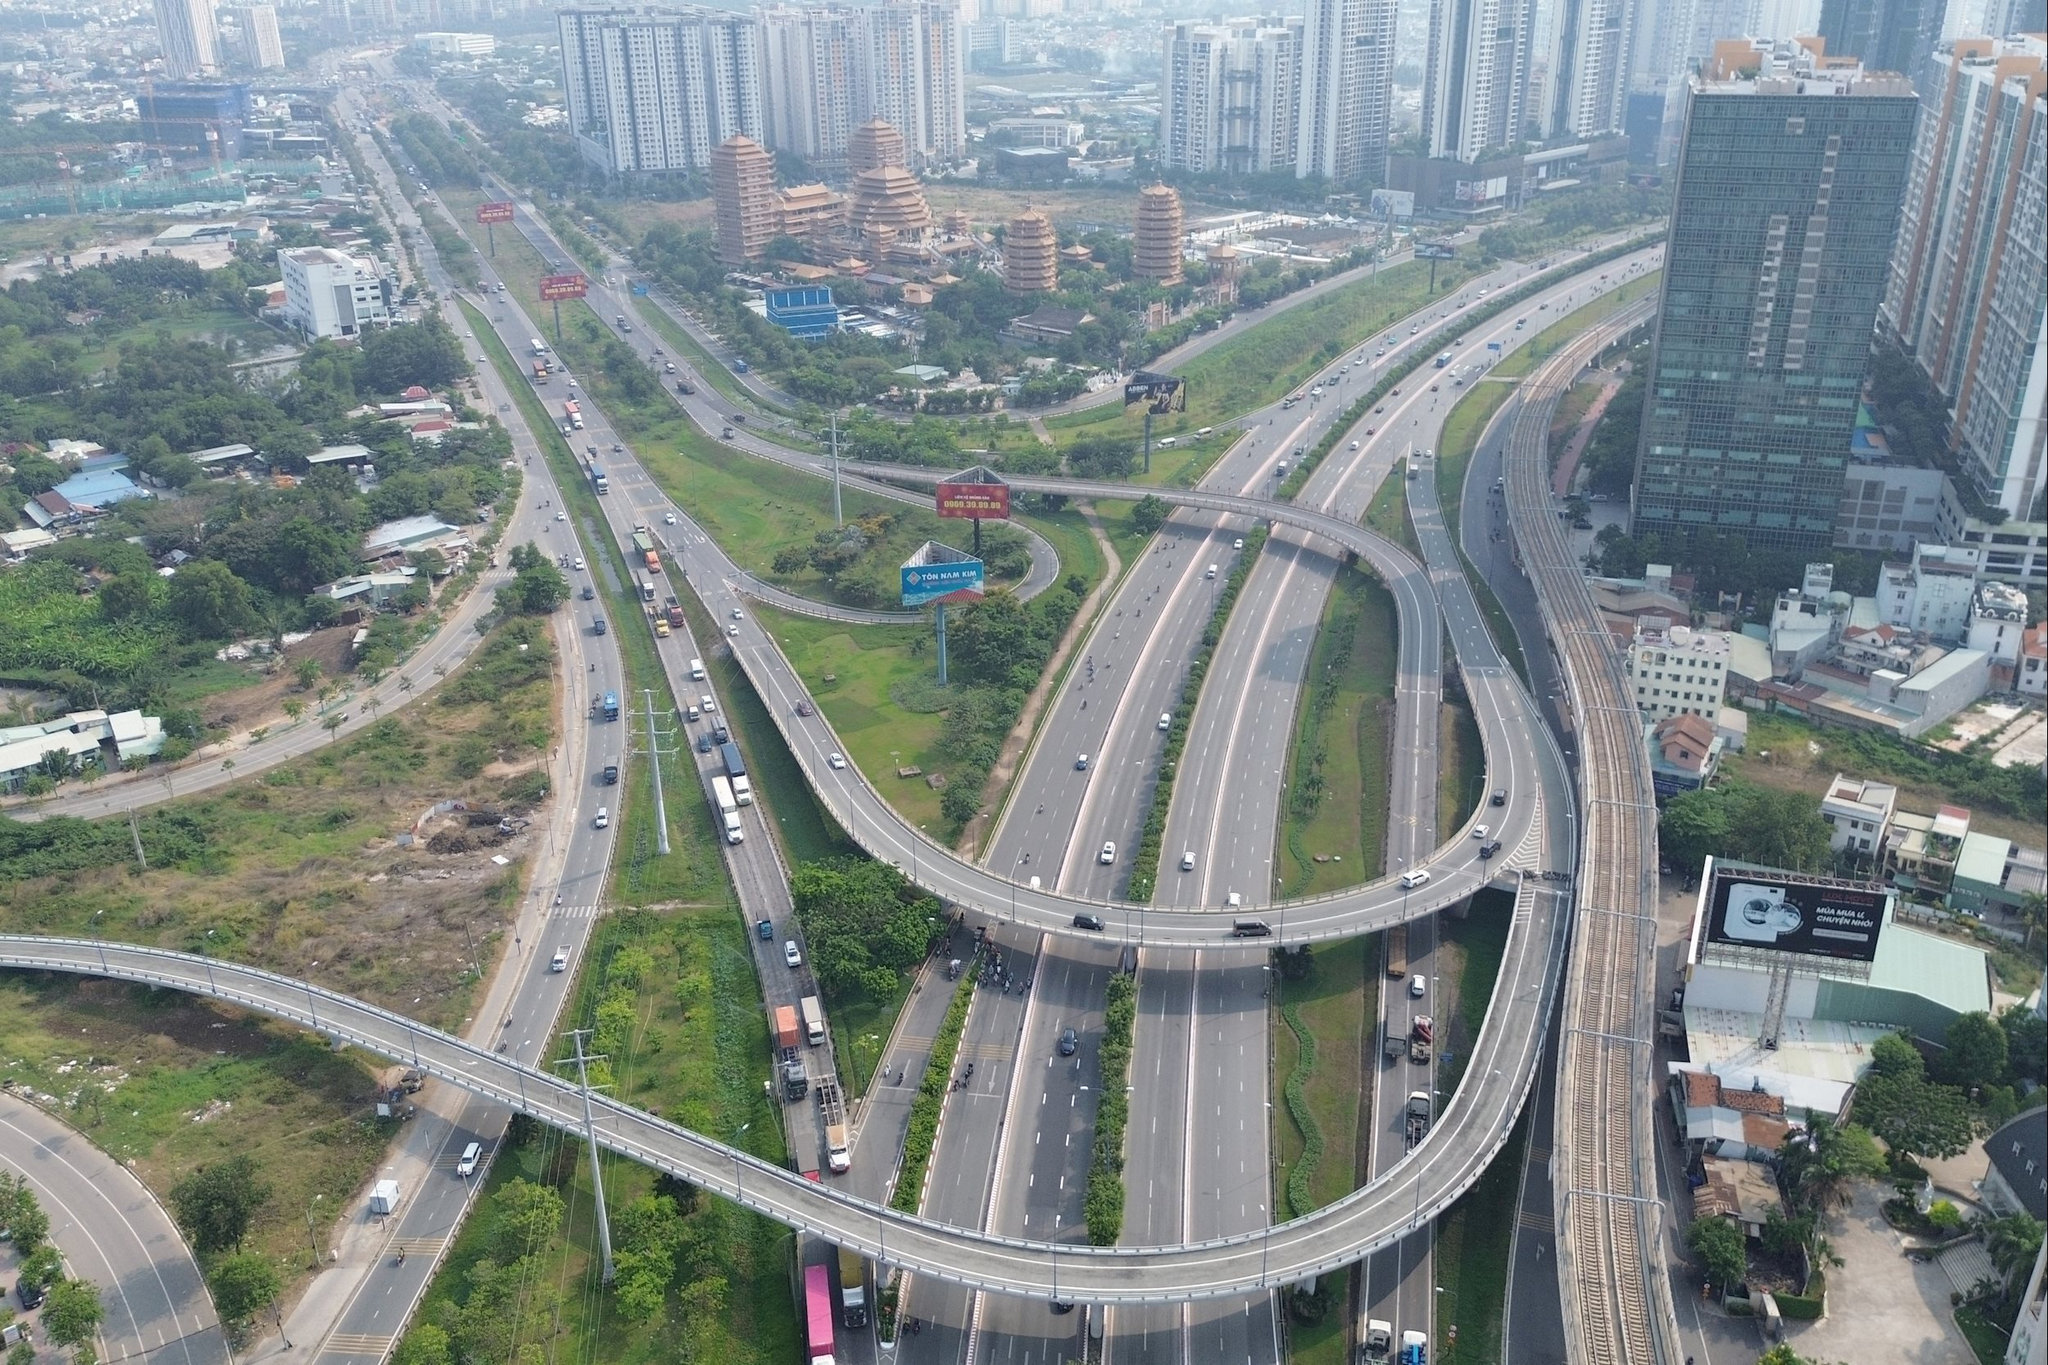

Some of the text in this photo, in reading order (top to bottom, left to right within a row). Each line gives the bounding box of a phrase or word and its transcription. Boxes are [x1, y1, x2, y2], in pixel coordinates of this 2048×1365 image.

[921, 570, 977, 580] TÔN NAM KIM
[1816, 914, 1850, 926] CHUYỆN
